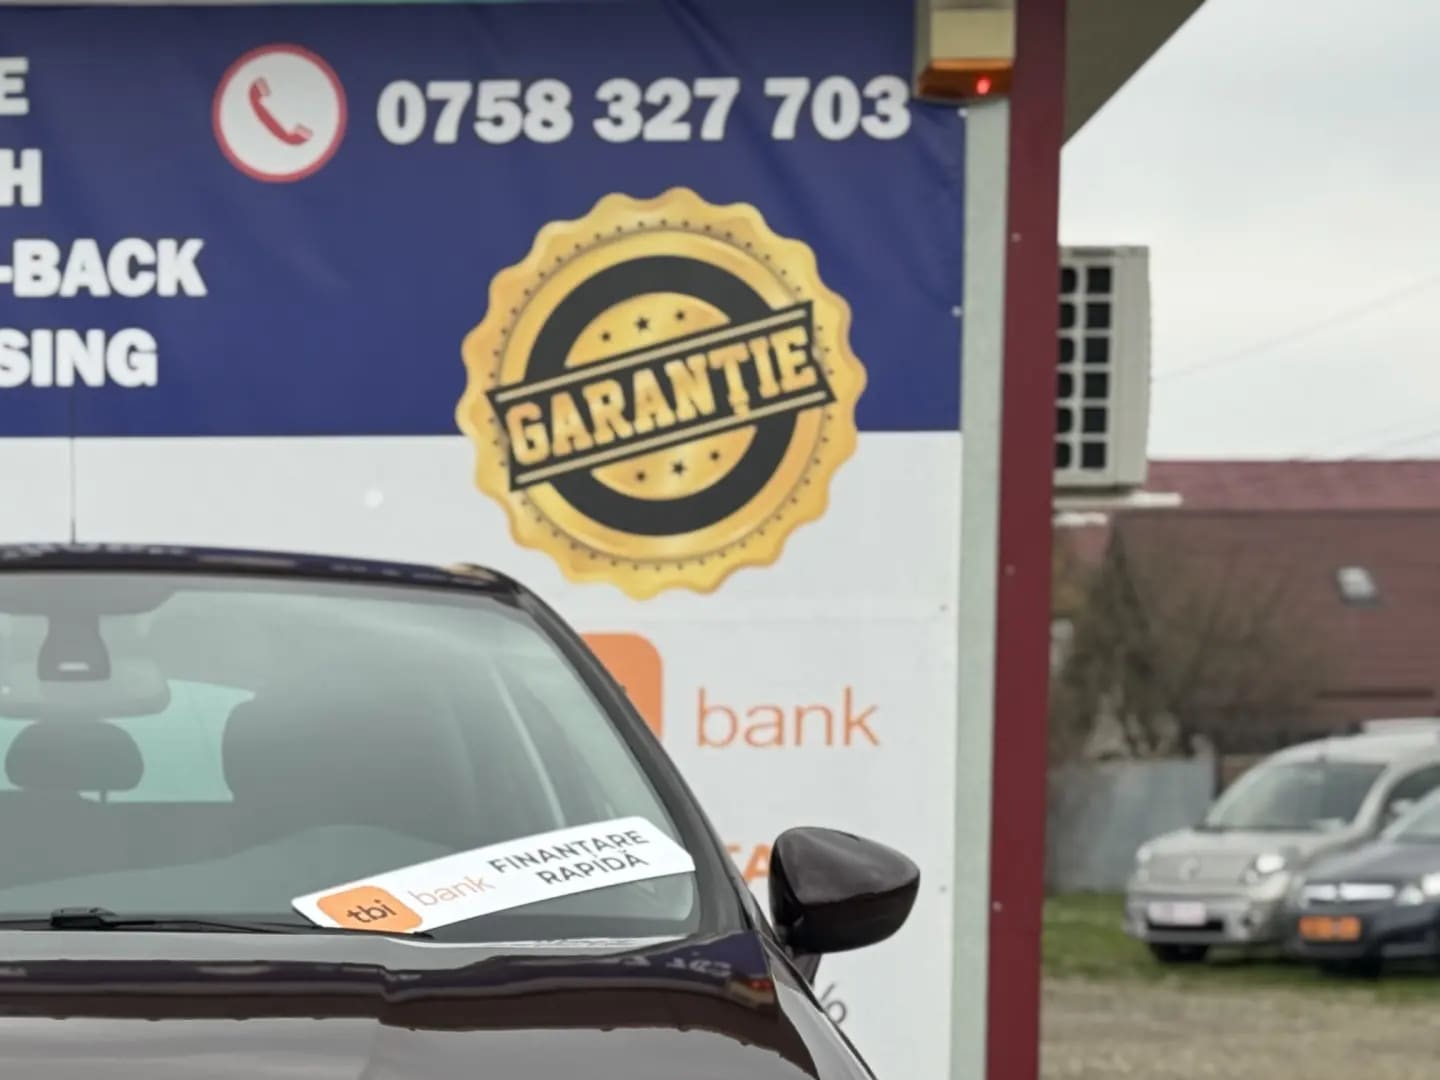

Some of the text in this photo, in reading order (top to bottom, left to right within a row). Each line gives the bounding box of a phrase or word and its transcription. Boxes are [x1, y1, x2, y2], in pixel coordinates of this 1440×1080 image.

[376, 75, 912, 145] 0758 327 703
[696, 686, 881, 748] bank
[536, 849, 648, 886] RAPIDĂ
[346, 873, 496, 925] tbi bank
